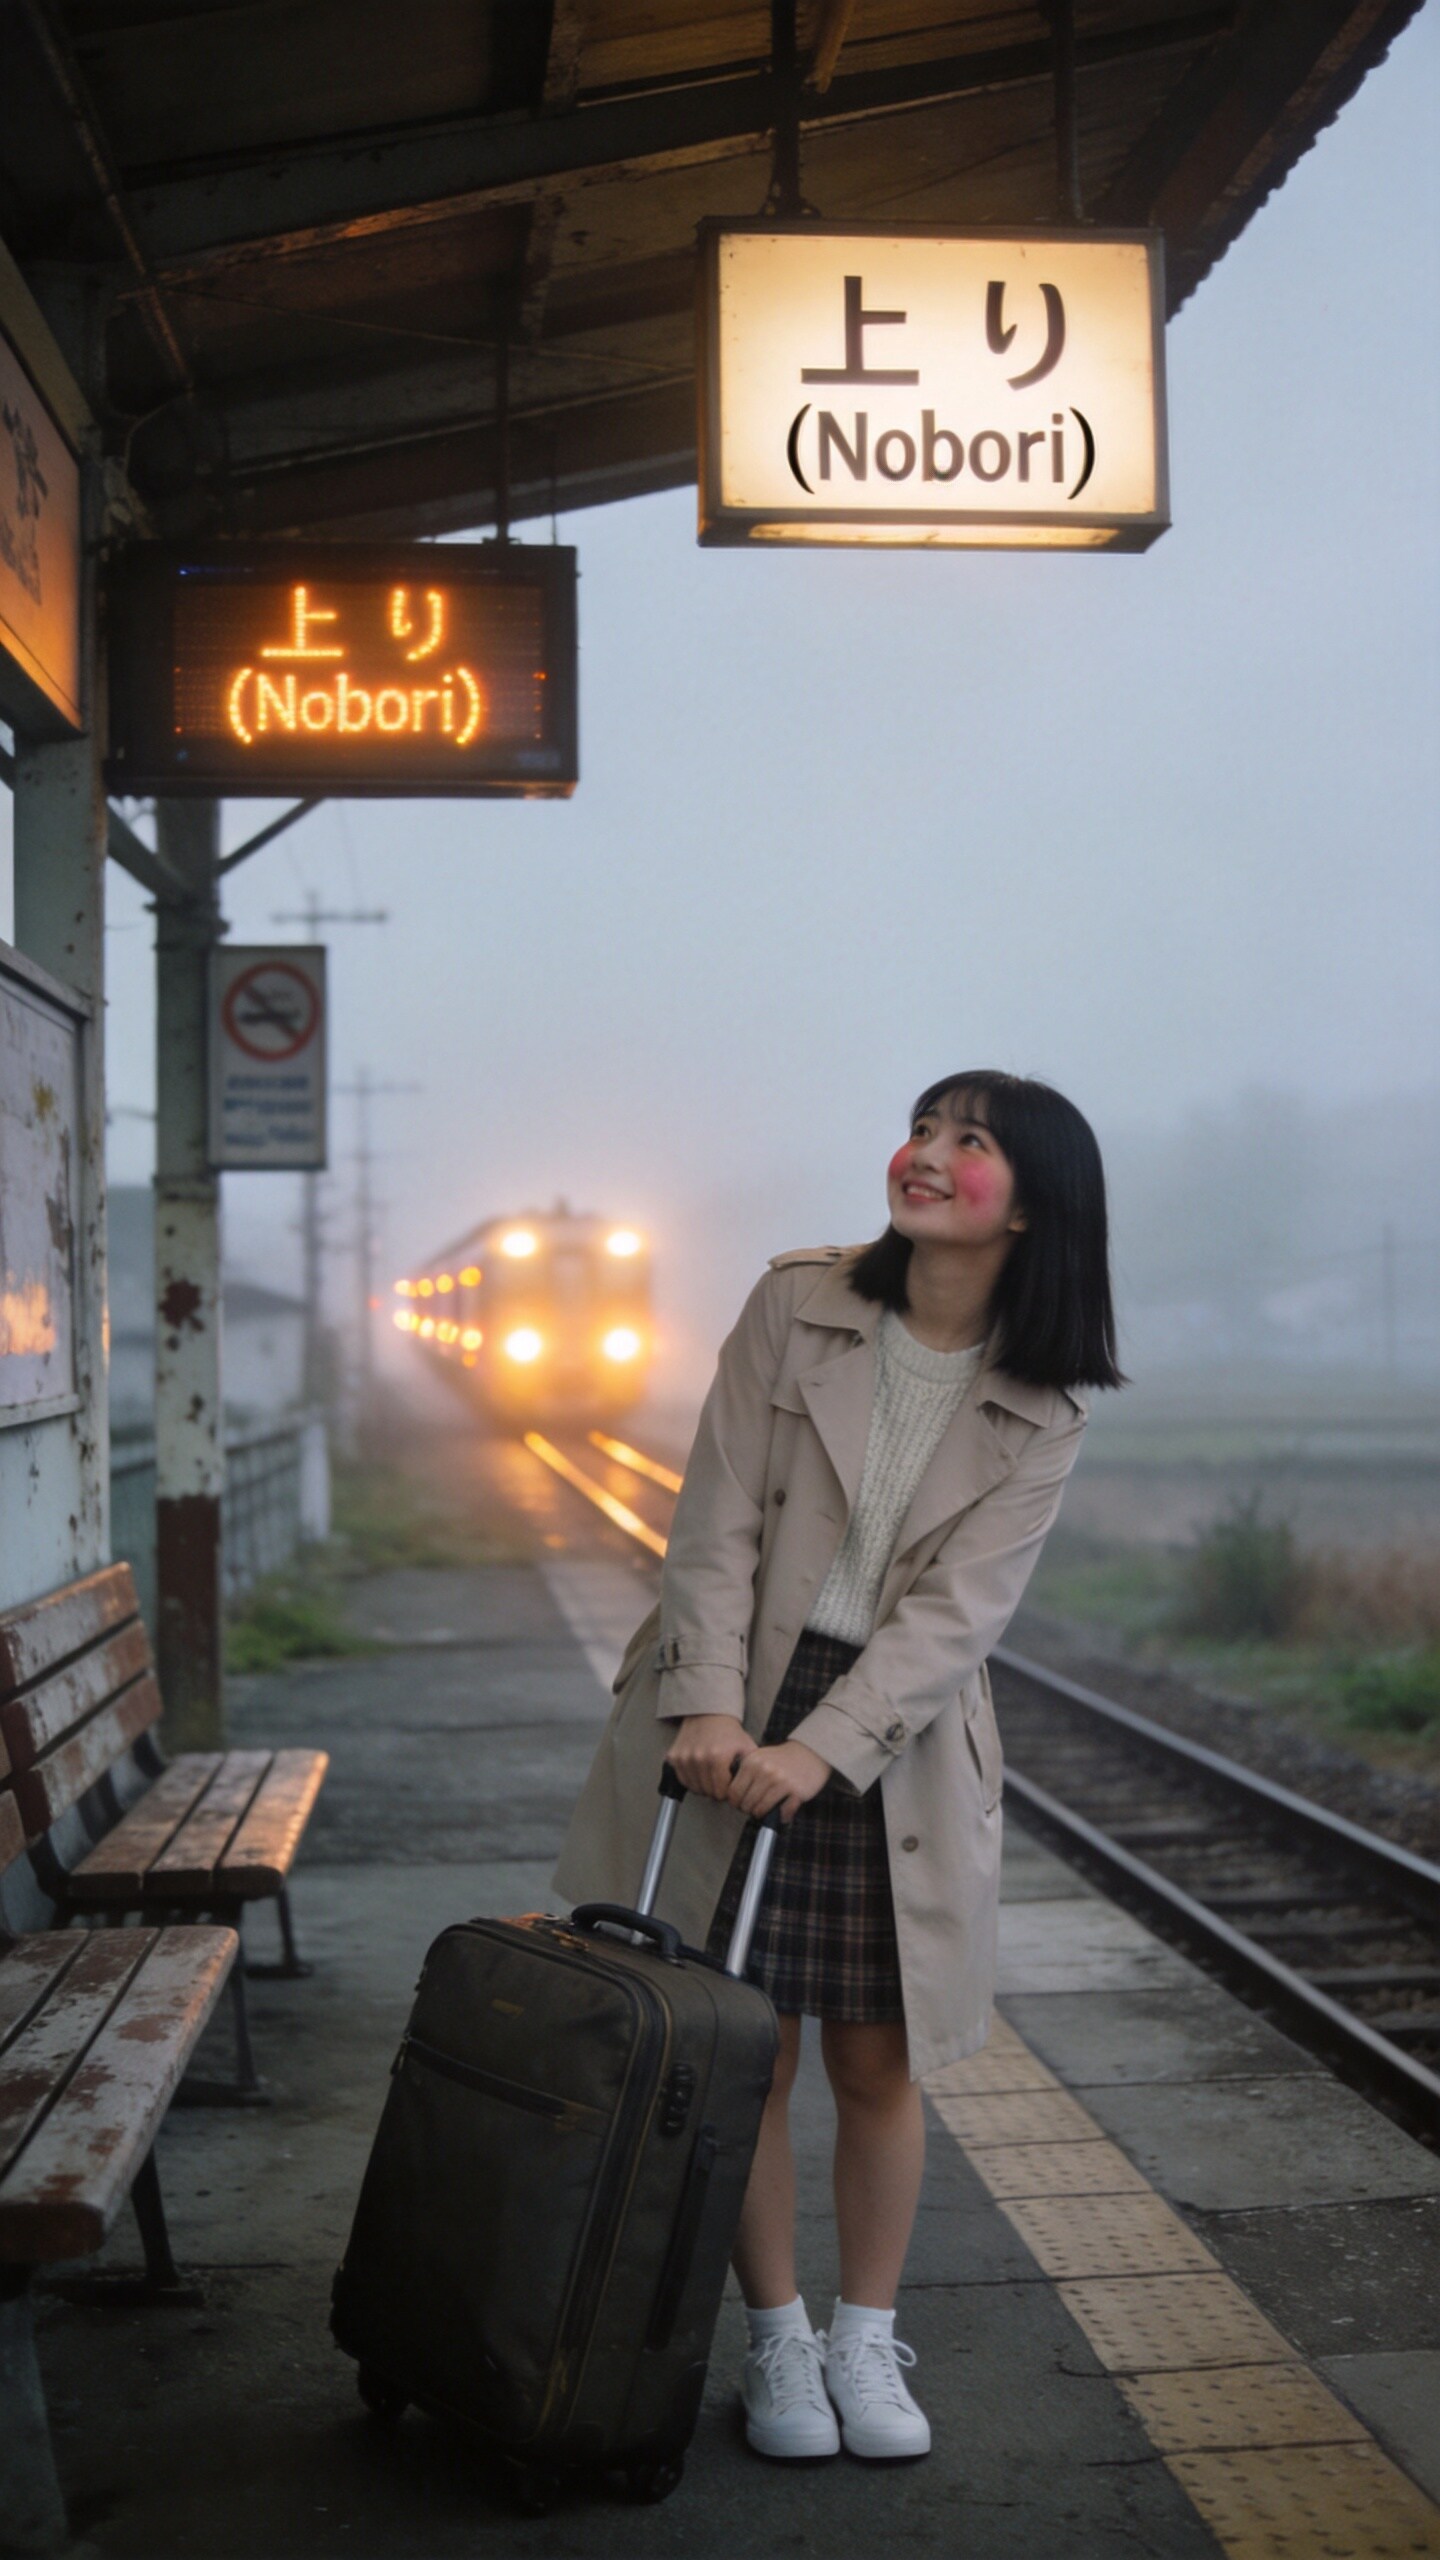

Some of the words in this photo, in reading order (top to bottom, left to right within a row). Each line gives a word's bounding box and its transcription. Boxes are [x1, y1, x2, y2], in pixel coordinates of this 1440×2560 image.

[800, 275, 1067, 391] 上り
[786, 402, 1096, 500] (Nobori)
[259, 584, 444, 661] 上り
[227, 666, 482, 746] (Nobori)
